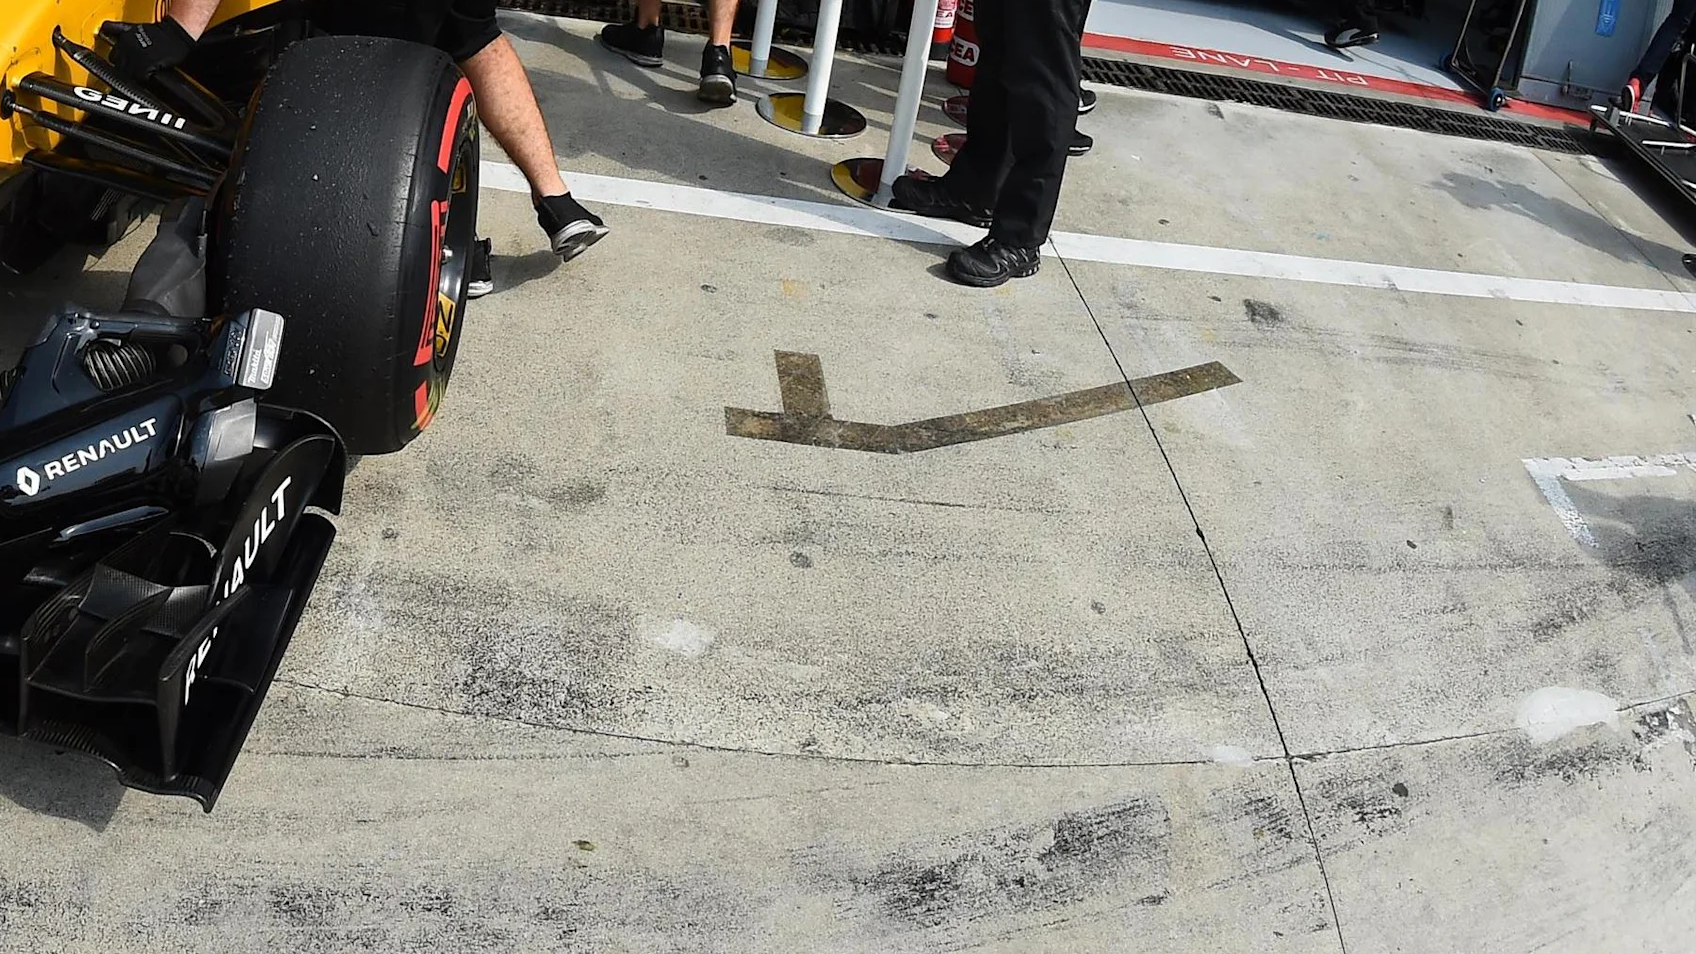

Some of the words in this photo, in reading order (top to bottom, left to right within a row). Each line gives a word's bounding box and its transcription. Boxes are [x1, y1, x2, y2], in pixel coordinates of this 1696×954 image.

[1170, 46, 1280, 72] LANE
[1316, 69, 1369, 86] PIT
[44, 417, 158, 481] RENAULT
